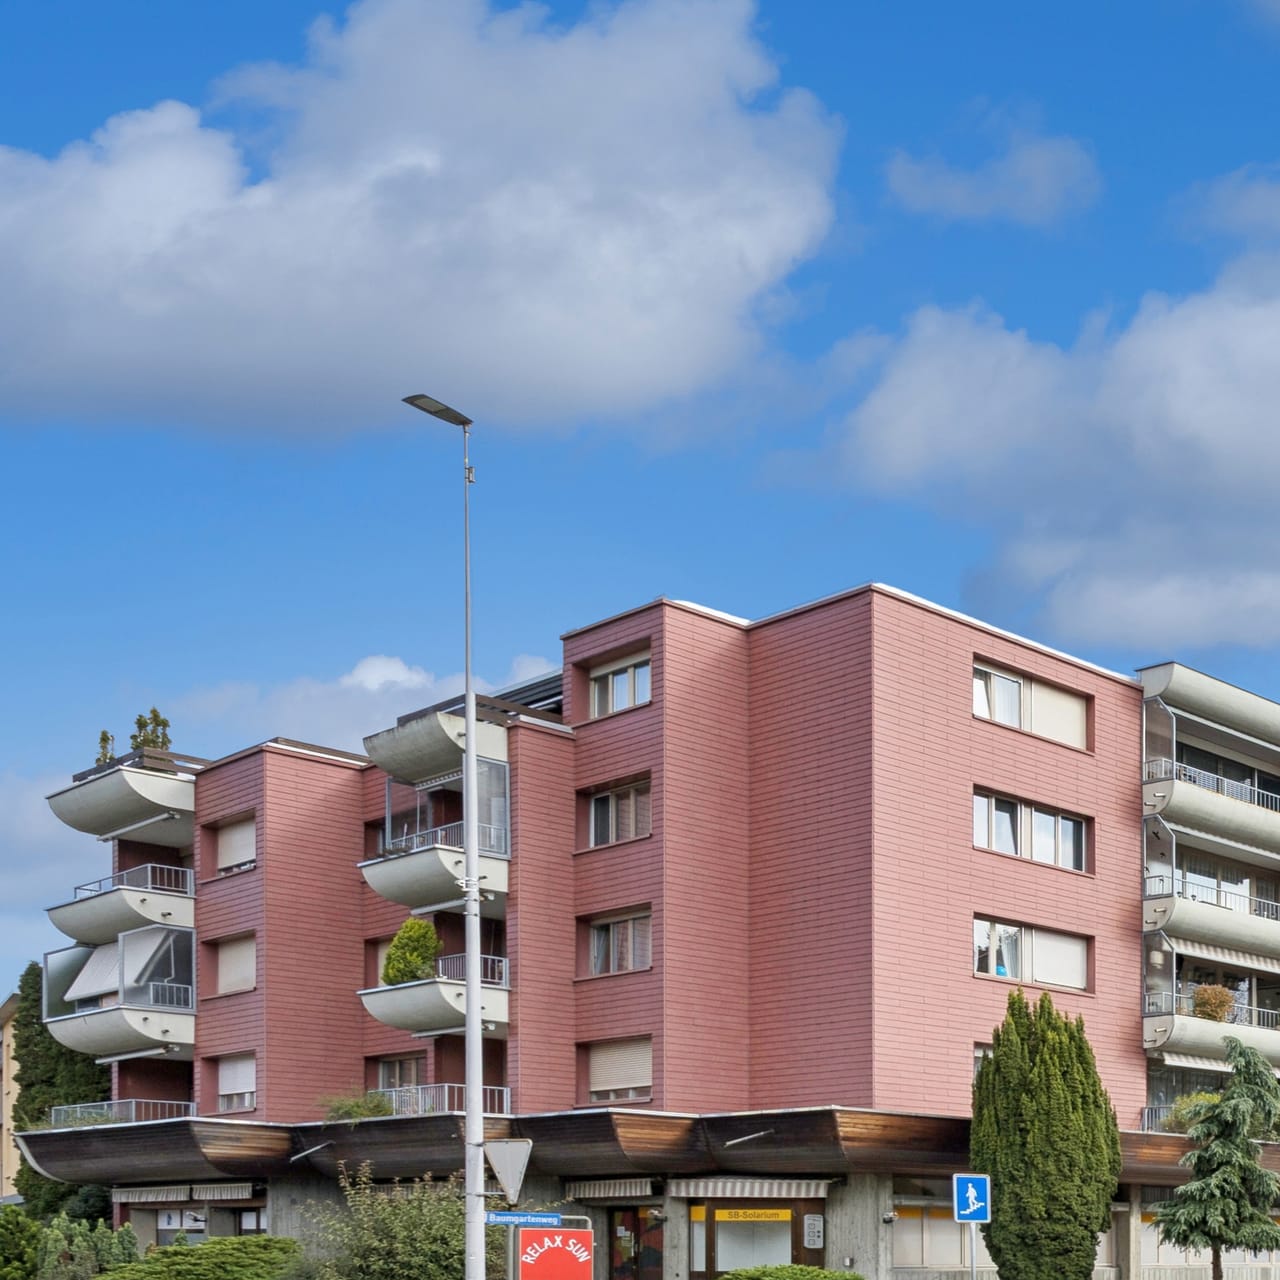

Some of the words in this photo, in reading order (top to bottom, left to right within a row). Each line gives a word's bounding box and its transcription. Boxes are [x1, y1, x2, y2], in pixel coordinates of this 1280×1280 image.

[489, 1213, 558, 1225] Baumgartenweg
[728, 1211, 780, 1219] SB-Solarium
[521, 1235, 563, 1265] RELAX
[565, 1238, 592, 1263] SUN
